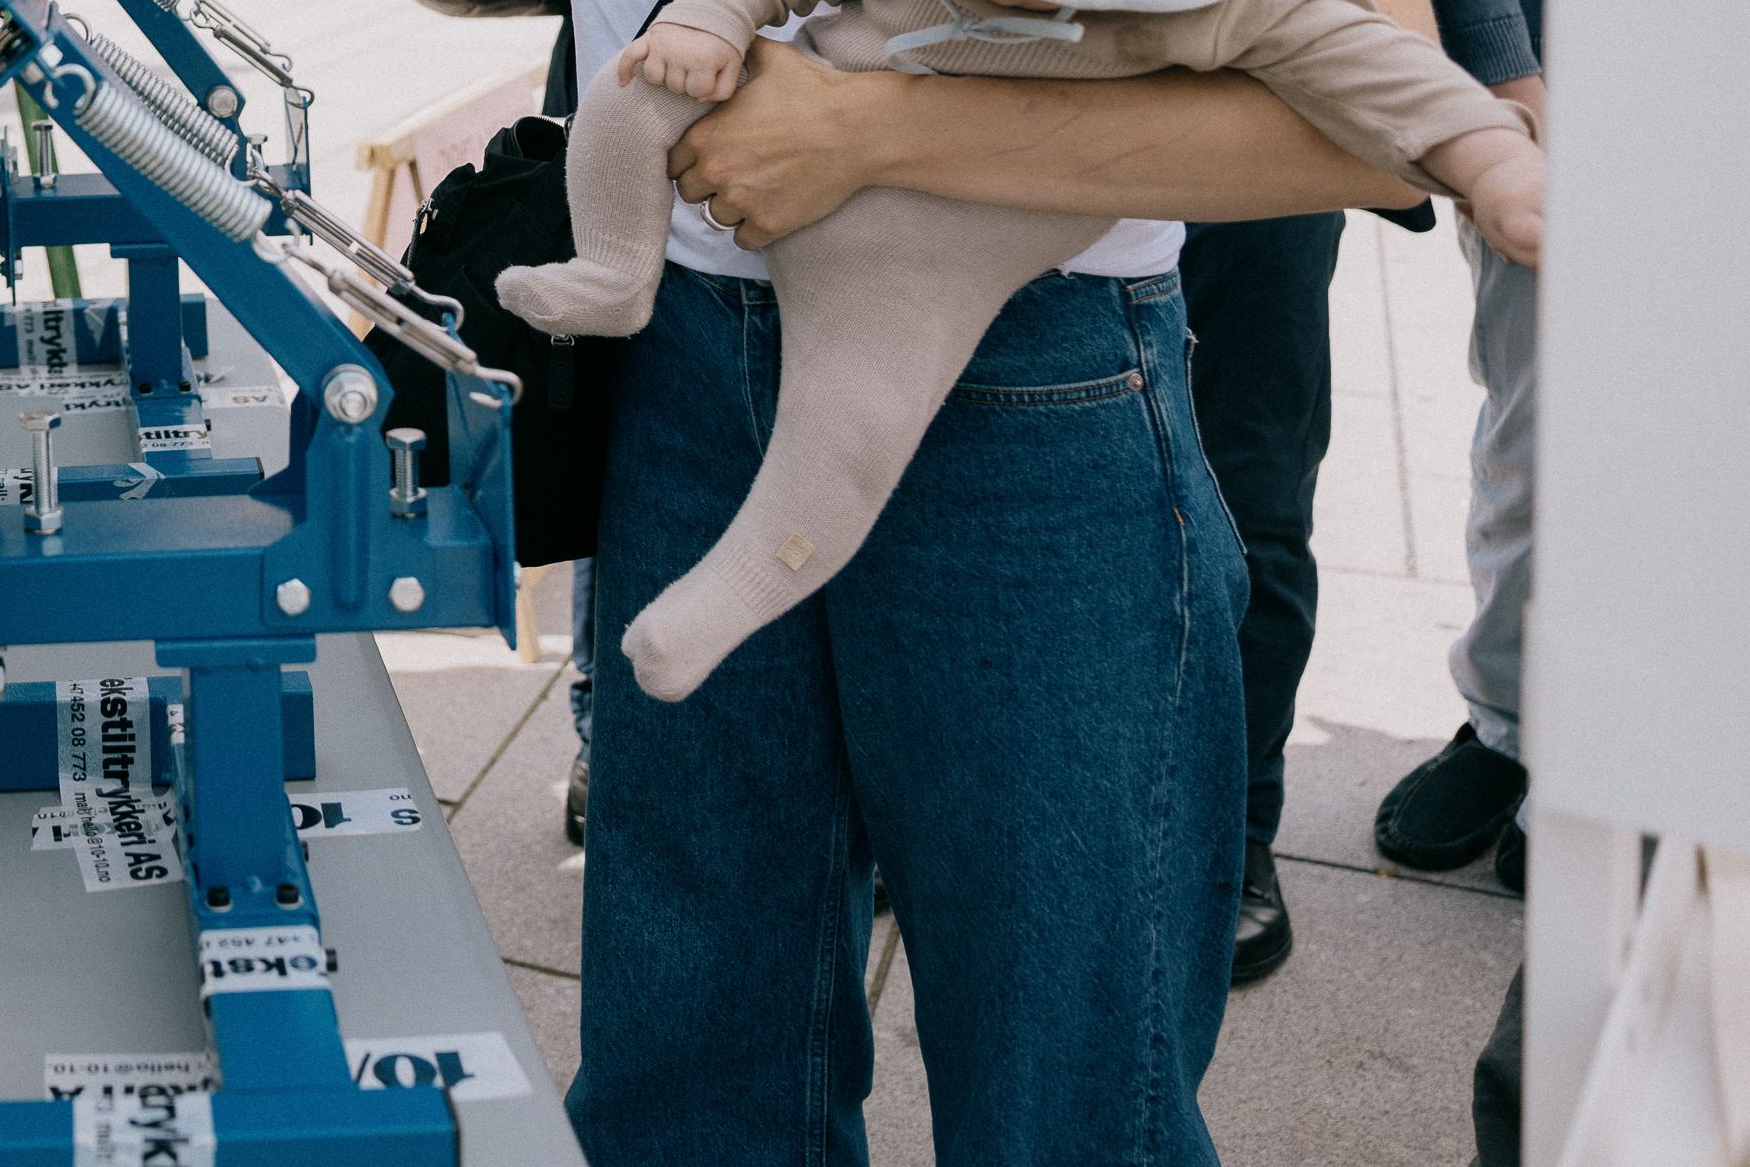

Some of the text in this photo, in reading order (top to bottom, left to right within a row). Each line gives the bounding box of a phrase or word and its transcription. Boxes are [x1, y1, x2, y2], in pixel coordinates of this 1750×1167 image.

[71, 727, 87, 747] 08
[72, 752, 87, 782] 773
[95, 677, 169, 881] ekstiltrykkeri AS
